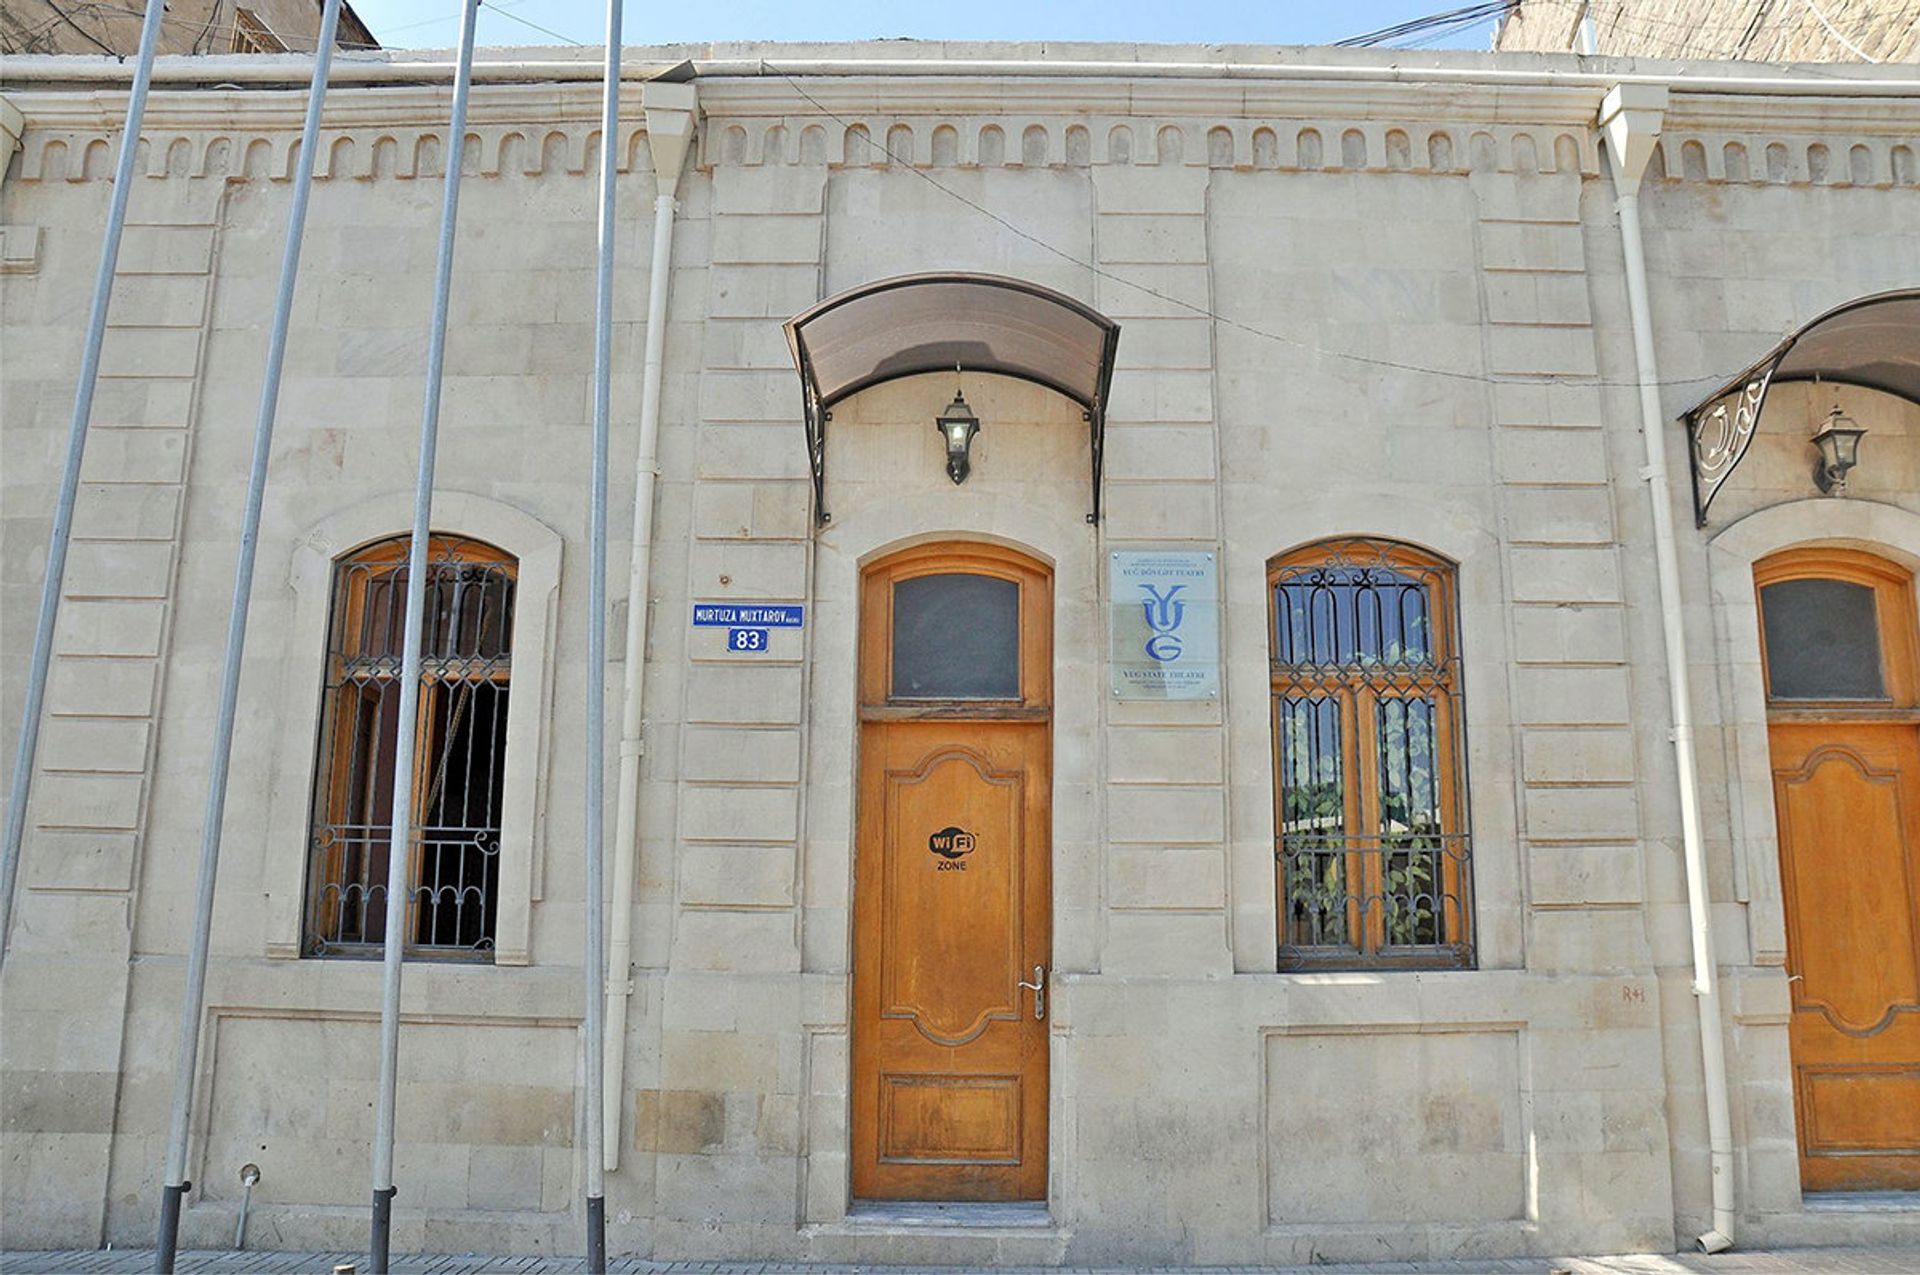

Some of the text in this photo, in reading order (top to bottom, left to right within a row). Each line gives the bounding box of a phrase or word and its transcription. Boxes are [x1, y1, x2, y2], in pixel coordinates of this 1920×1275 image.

[696, 609, 737, 622] MURTUZA
[740, 610, 787, 622] MUXTAROV
[736, 630, 760, 649] 83
[937, 861, 967, 871] ZONE
